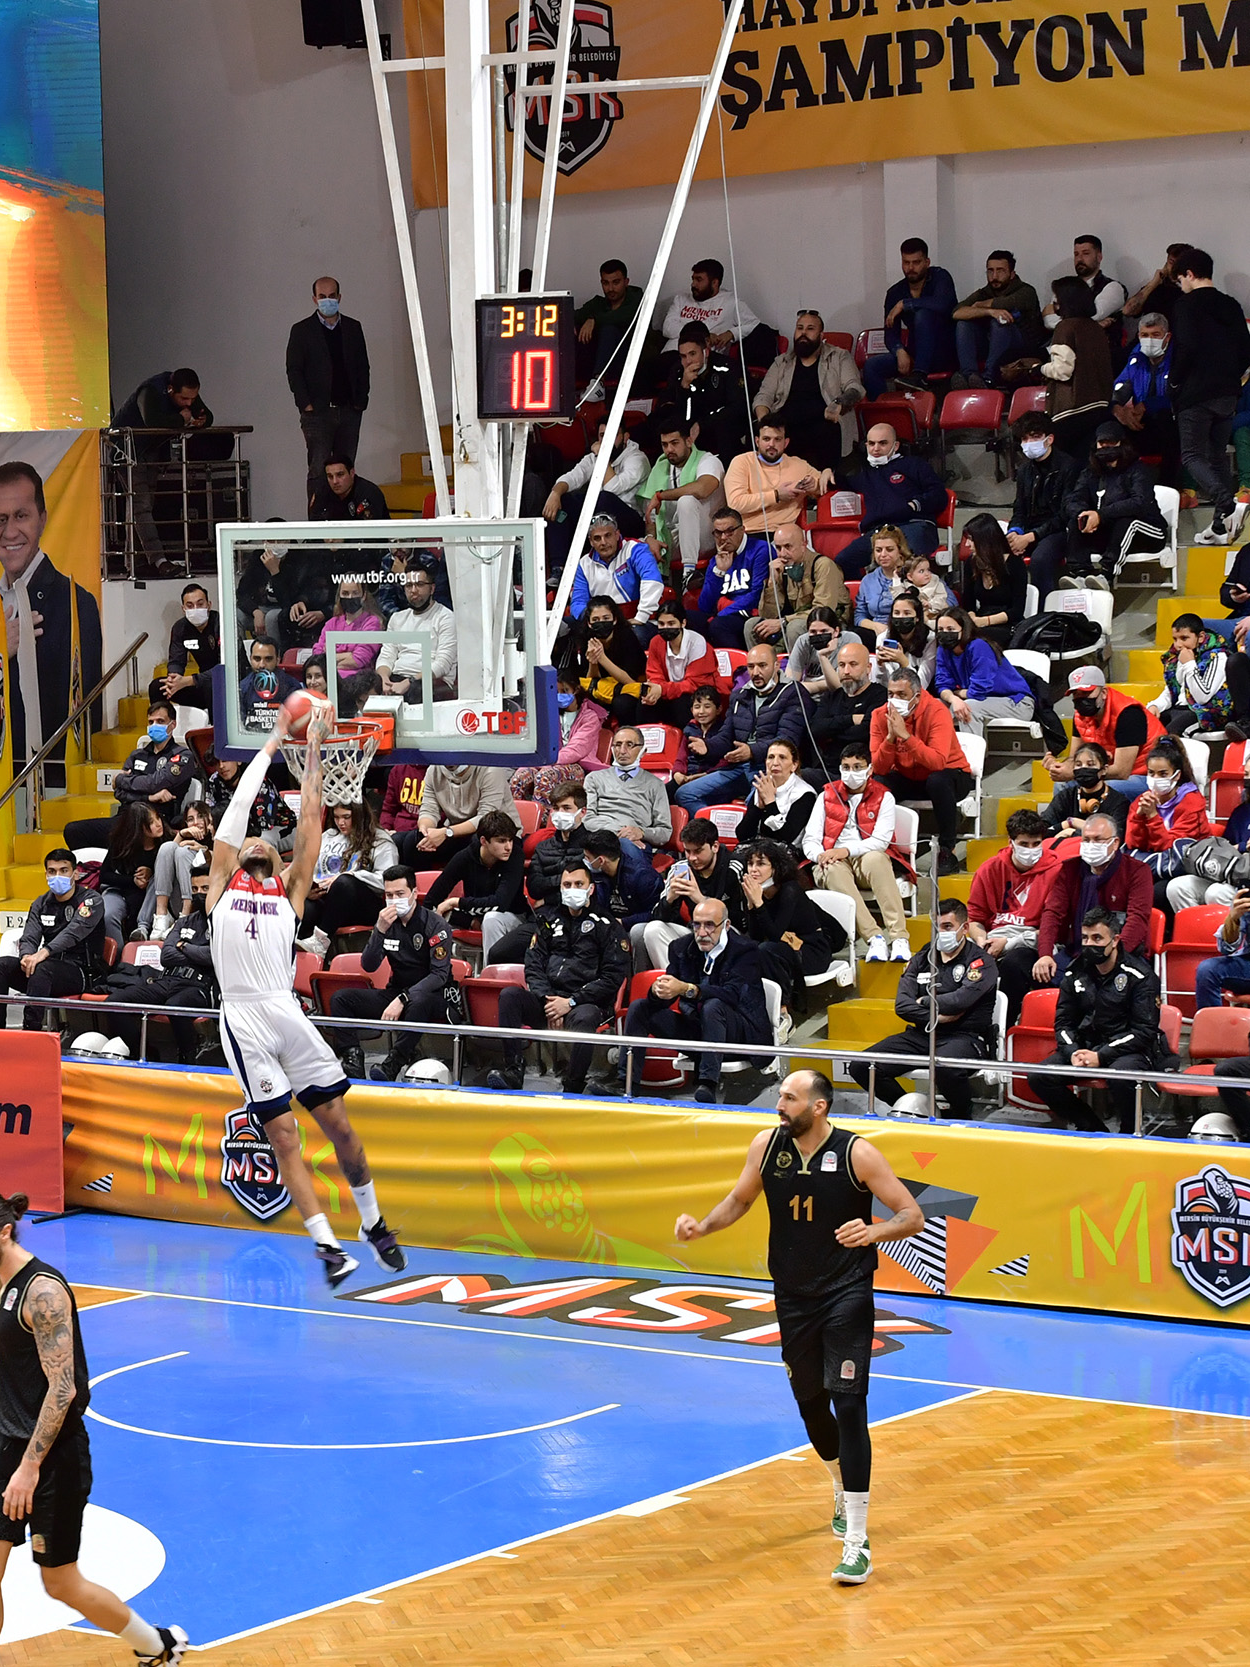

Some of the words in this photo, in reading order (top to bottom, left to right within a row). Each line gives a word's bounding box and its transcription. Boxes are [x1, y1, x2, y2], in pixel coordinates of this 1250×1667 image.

[579, 51, 616, 62] BELEDİYESİ
[721, 8, 1147, 130] ŞAMPİYON
[501, 305, 557, 338] 3:12
[511, 351, 552, 409] 10
[331, 570, 421, 585] www.tbf.org.tr
[481, 711, 527, 735] TBF
[245, 917, 259, 940] 4
[789, 1195, 813, 1221] 11
